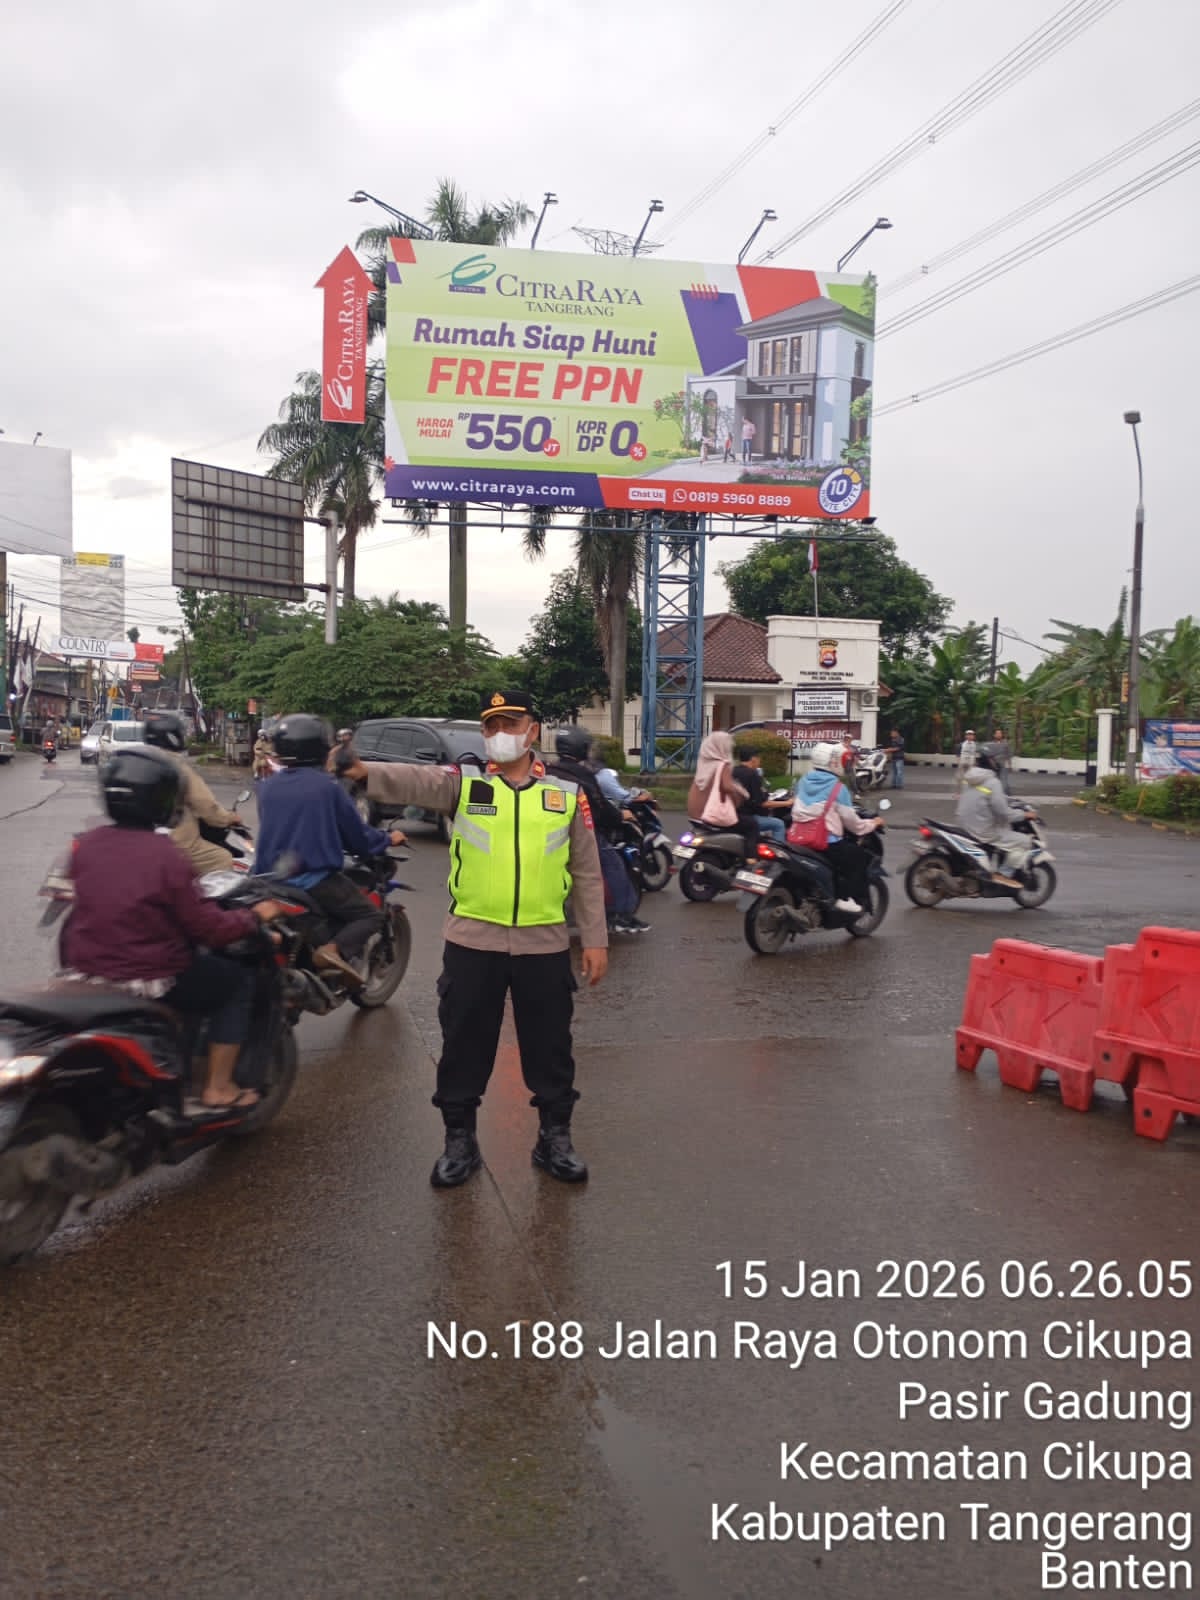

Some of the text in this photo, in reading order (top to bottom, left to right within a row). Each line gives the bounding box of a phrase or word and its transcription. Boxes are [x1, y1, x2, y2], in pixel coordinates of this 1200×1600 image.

[495, 273, 644, 306] CITRARAYA
[525, 301, 615, 317] TANGERANG
[355, 298, 364, 360] TANGERANG
[413, 318, 657, 360] Rumah Siap Huni
[427, 356, 643, 404] FREE PPN
[416, 416, 453, 429] HARGA
[576, 420, 607, 434] KPR
[419, 428, 452, 440] MULAI
[458, 411, 559, 454] RP 550 JT
[577, 435, 604, 452] DP
[412, 479, 575, 497] www.citraraya.com
[631, 489, 664, 500] Chat Us
[830, 479, 848, 496] 10
[689, 491, 791, 507] 0819 5960 8889
[58, 638, 108, 653] COUNTRY
[811, 729, 847, 739] UNTUK
